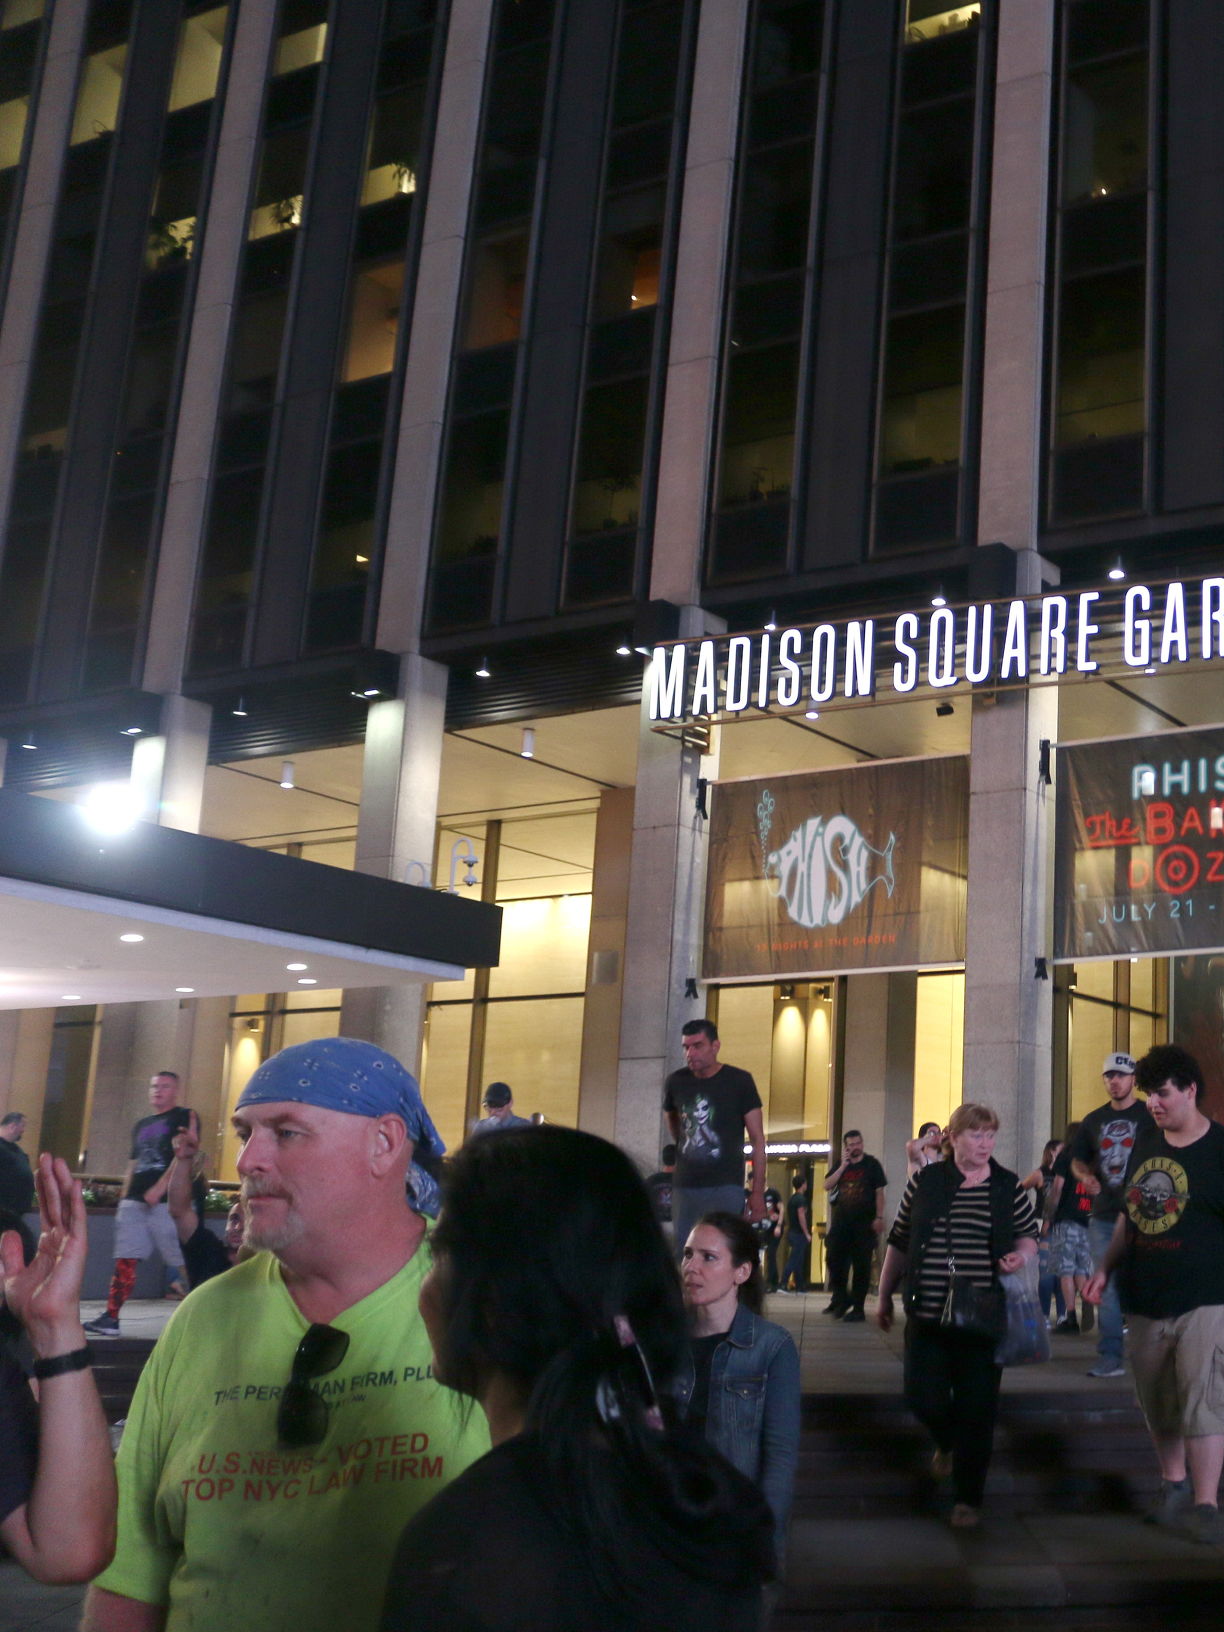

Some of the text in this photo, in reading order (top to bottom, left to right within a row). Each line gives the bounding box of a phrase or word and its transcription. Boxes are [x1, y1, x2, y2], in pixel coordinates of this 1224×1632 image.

[649, 619, 875, 719] MADISON
[894, 590, 1100, 692] SQUARE
[1086, 811, 1141, 843] The
[1098, 903, 1157, 924] JULY
[1170, 899, 1194, 919] 21
[829, 937, 849, 947] THE
[214, 1385, 241, 1406] THE
[350, 1370, 398, 1391] FIRM,
[337, 1433, 430, 1466] VOTED
[181, 1456, 445, 1502] TOP NYC LAW FIRM
